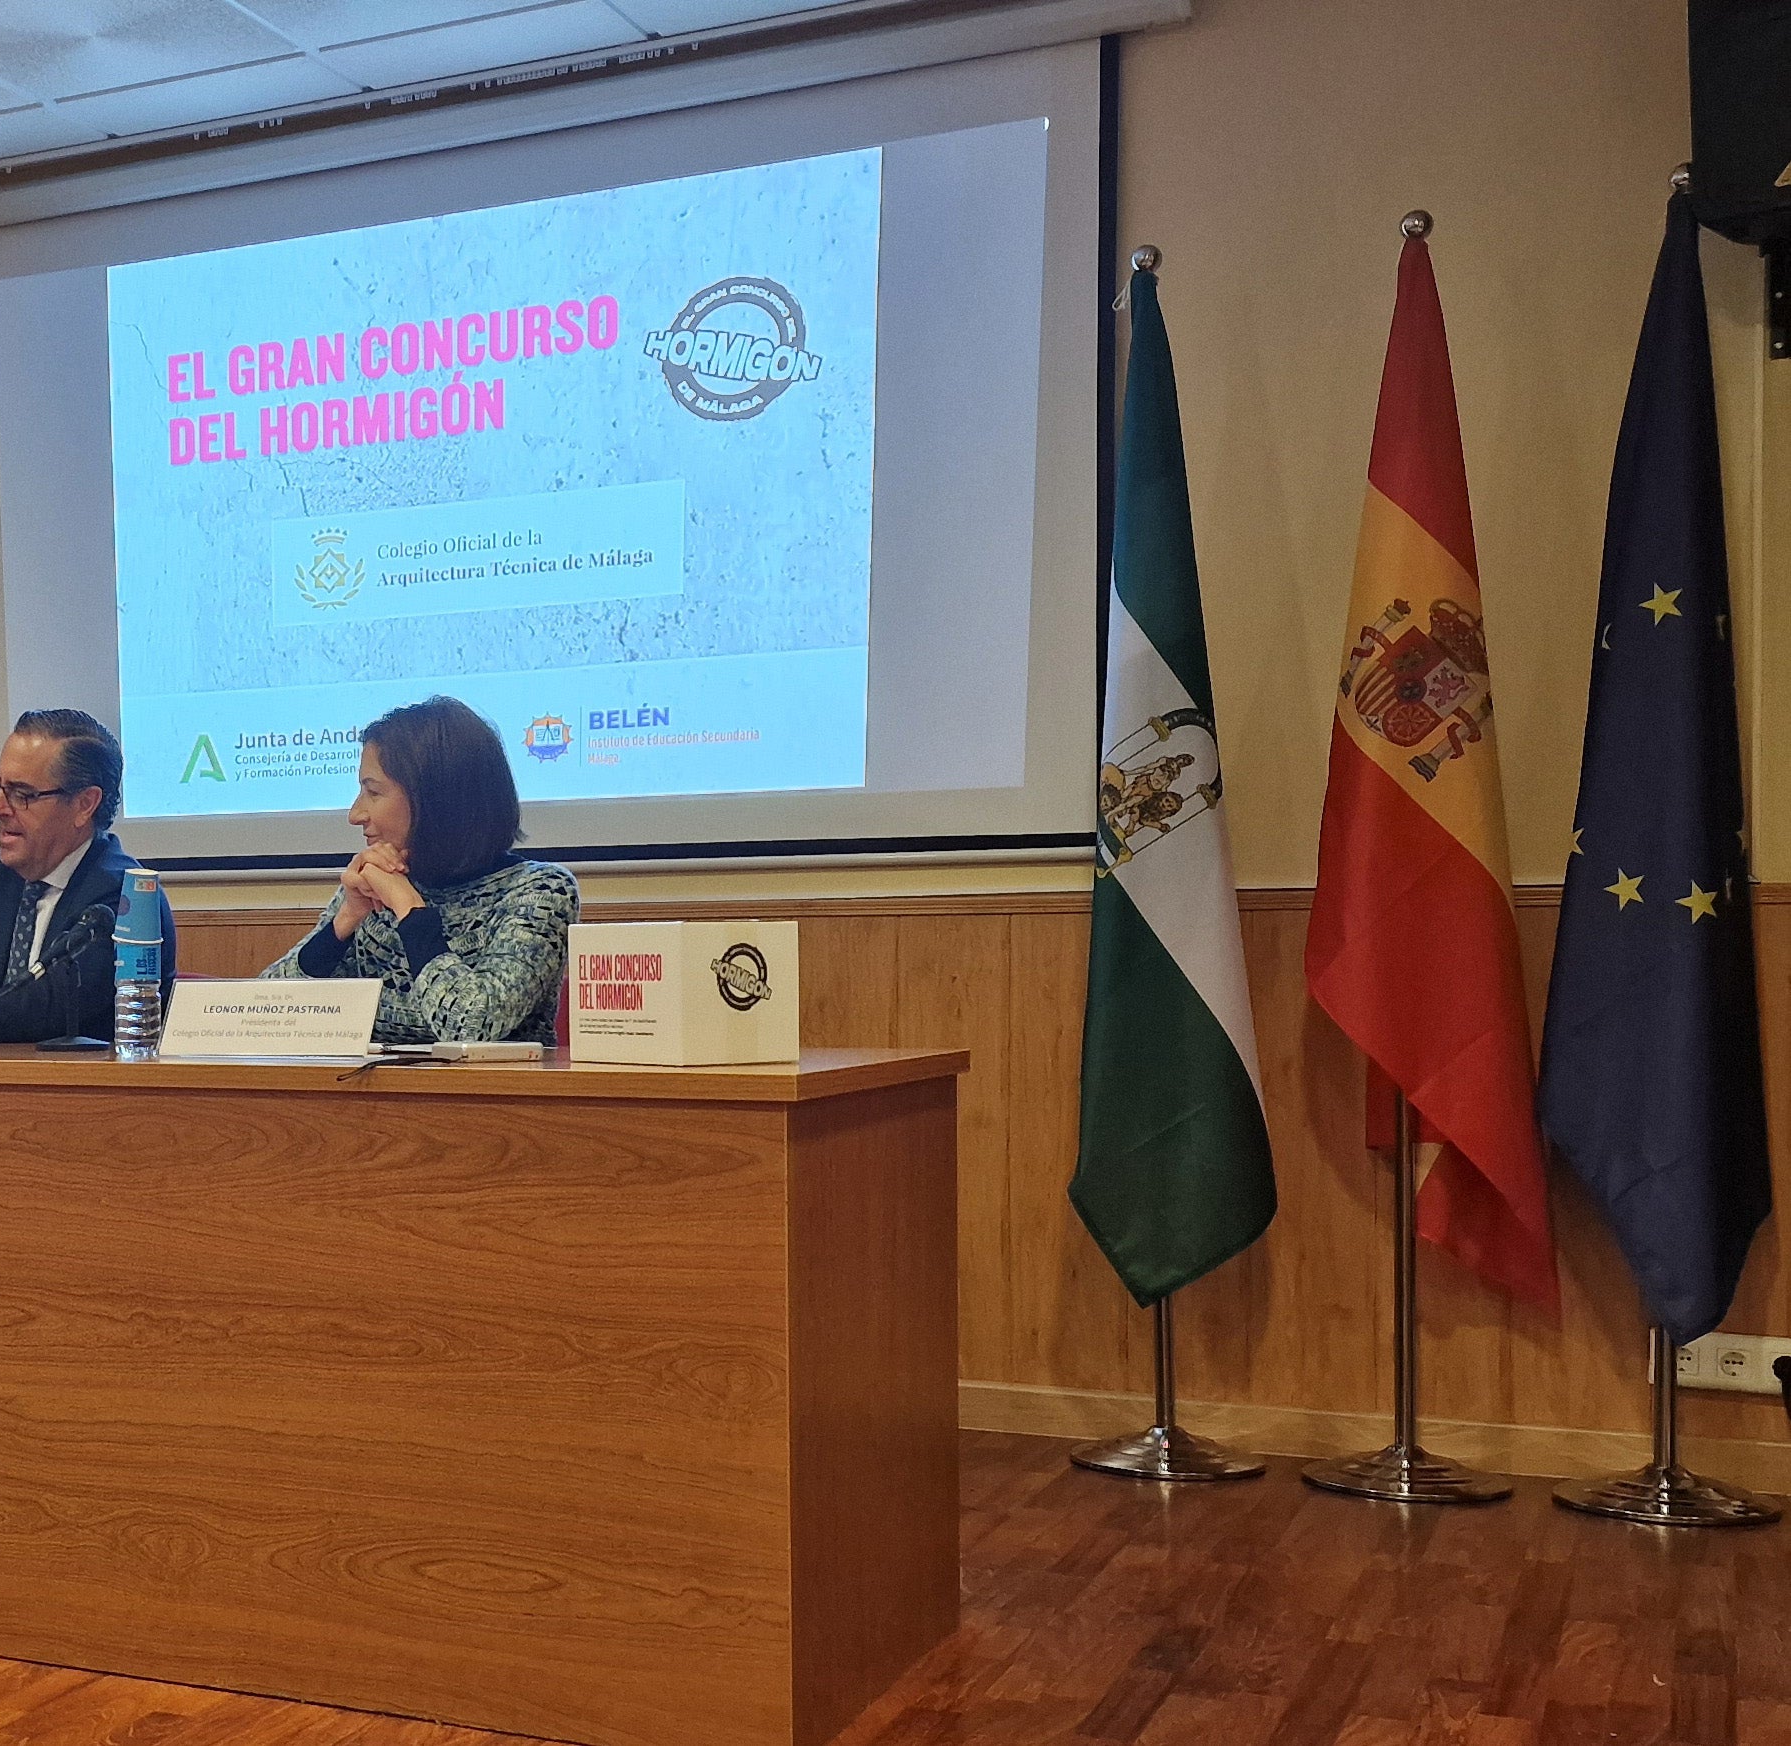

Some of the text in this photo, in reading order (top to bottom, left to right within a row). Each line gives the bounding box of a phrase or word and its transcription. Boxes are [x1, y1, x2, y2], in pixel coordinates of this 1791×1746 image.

[168, 294, 619, 403] EL GRAN CONCURSO
[169, 370, 504, 466] DEL HORMIGÓN
[377, 529, 543, 560] Colegio Oficial de la
[376, 548, 654, 588] Arquitectura Técnica de Málaga
[589, 702, 670, 730] BELÉN
[234, 732, 287, 749] Junta
[292, 729, 315, 746] de
[588, 728, 760, 748] Instituto de Educación Secundaria
[235, 751, 291, 766] Consejería
[294, 751, 308, 762] de
[235, 770, 242, 781] y
[244, 764, 301, 778] Formación
[579, 953, 662, 981] EL GRAN CONCURSO
[203, 1003, 341, 1014] LEONOR MUÑOZ PASTRANA
[579, 983, 594, 1010] DEL
